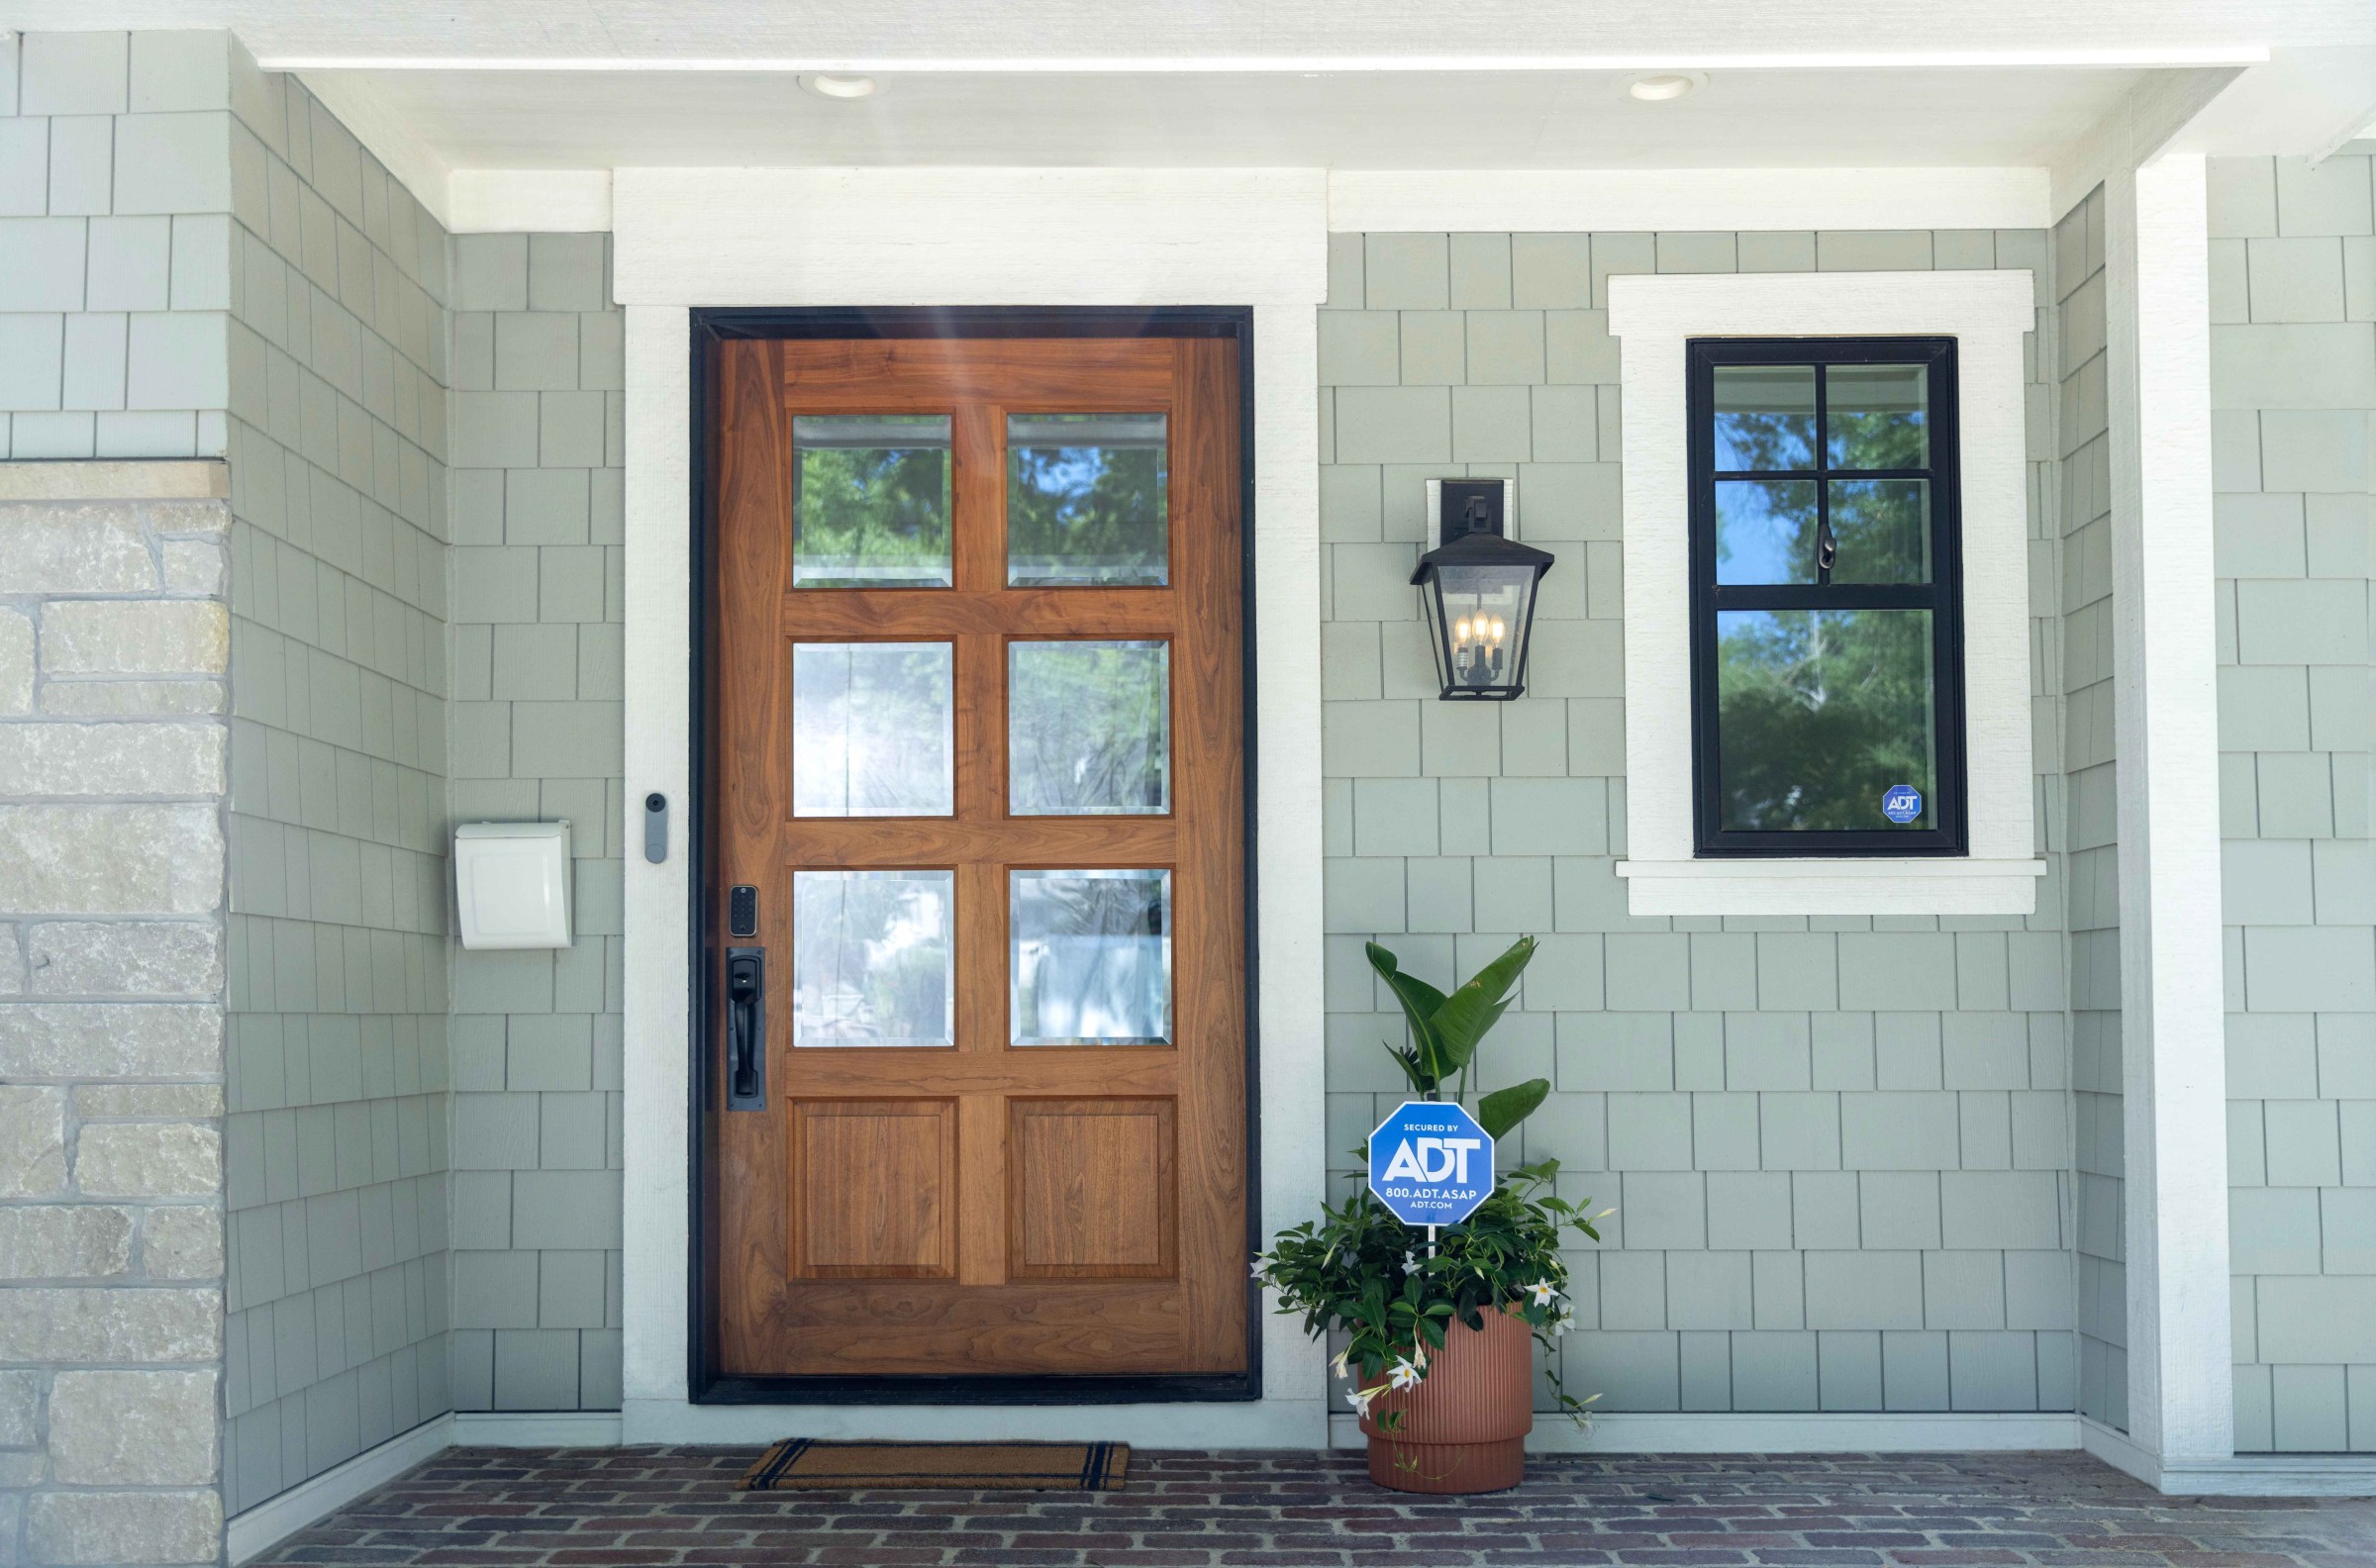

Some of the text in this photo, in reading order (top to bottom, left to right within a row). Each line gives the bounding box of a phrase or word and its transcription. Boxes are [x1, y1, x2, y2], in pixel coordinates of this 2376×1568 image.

[1887, 796, 1917, 810] ADT
[1382, 1137, 1480, 1184] ADT
[1386, 1188, 1476, 1200] 800.ADT.ASAP
